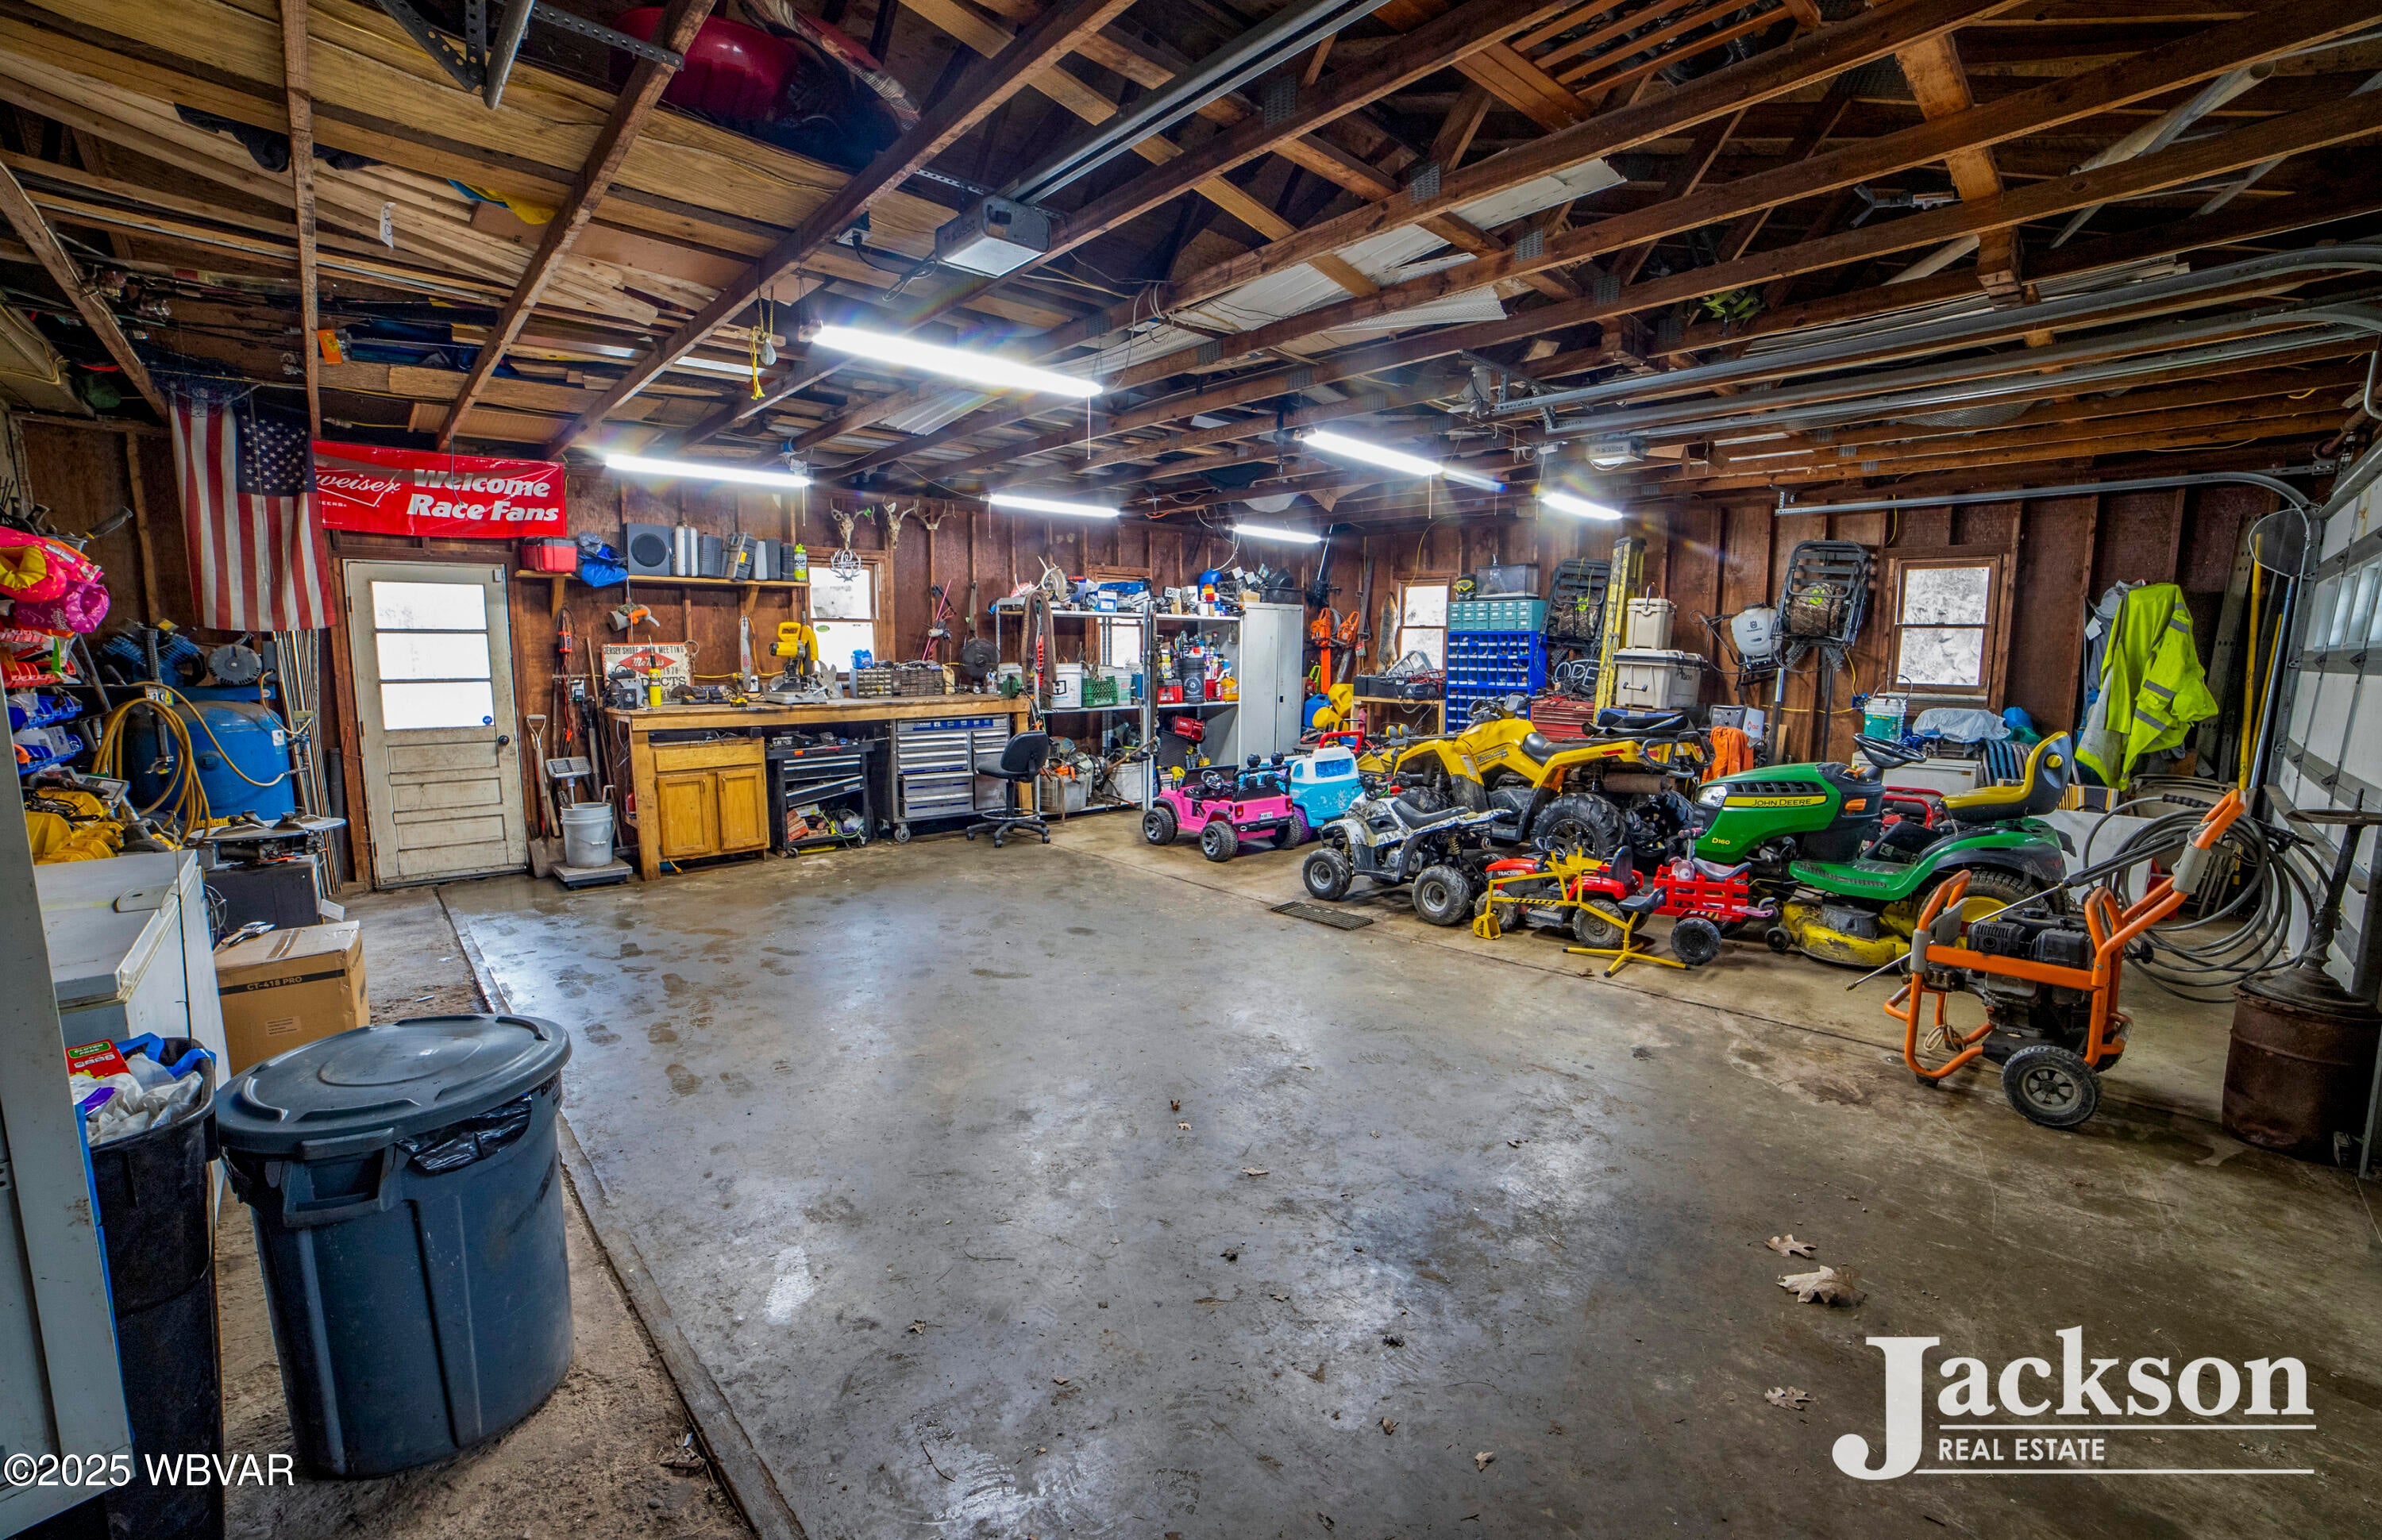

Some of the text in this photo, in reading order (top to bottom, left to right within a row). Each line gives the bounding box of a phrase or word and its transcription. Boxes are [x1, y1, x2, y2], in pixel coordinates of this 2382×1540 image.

[316, 473, 402, 493] weiser
[413, 468, 550, 498] Welcome
[406, 493, 559, 522] Race Fans
[658, 645, 684, 654] MEETING
[1554, 661, 1600, 687] OPE
[1779, 798, 1812, 807] DEERE
[246, 976, 303, 991] CT-418 PRO
